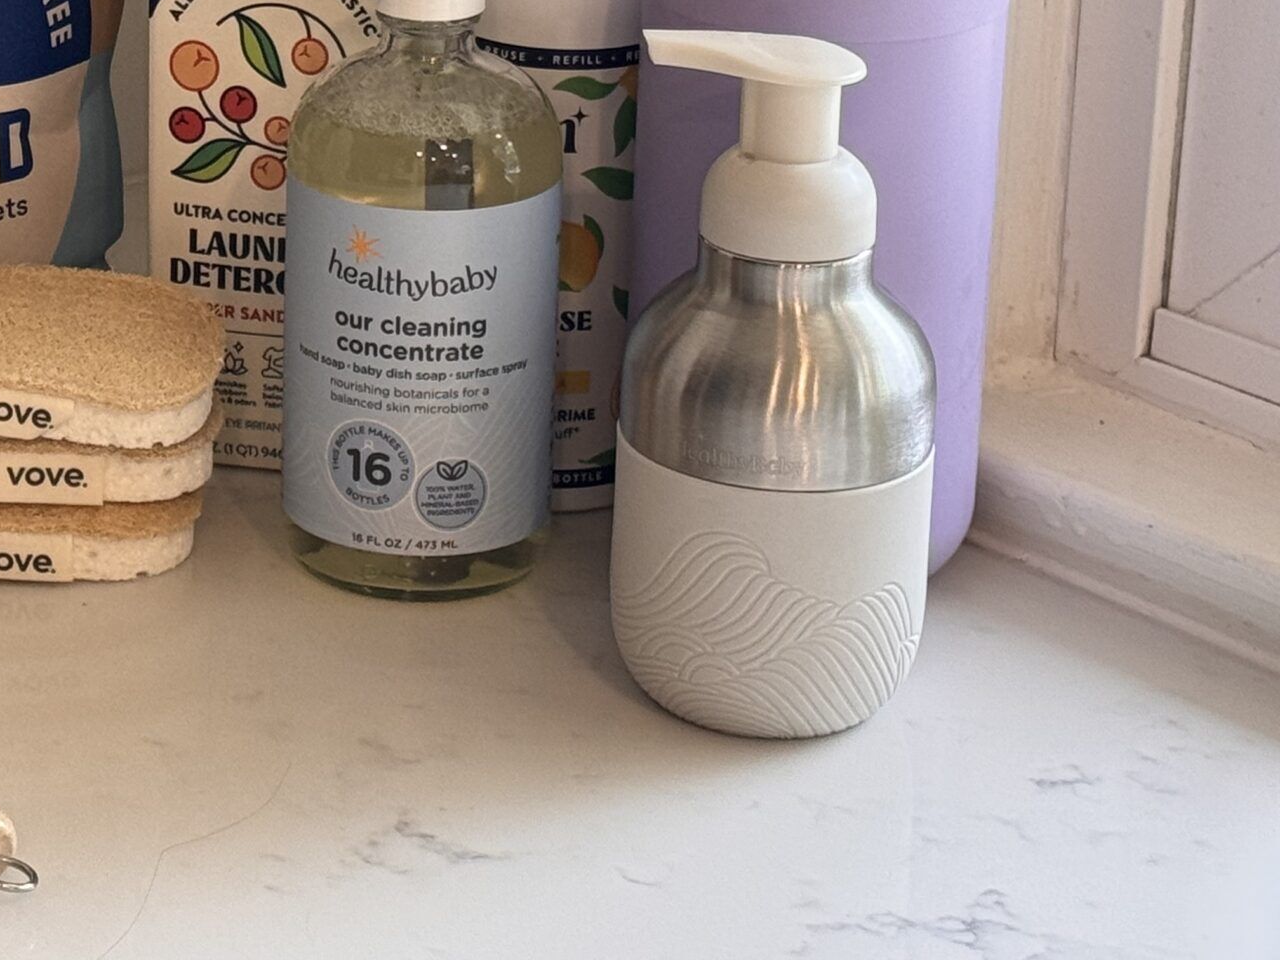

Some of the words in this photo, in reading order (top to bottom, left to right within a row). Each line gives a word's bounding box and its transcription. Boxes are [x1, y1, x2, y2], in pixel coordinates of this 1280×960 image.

[552, 54, 603, 66] REFILL
[174, 202, 223, 221] ULTRA
[328, 247, 498, 302] healthybaby
[334, 310, 373, 331] our
[380, 315, 487, 339] cleaning
[336, 335, 484, 362] concentrate
[299, 343, 320, 362] hand
[321, 355, 346, 371] soap
[352, 361, 382, 380] baby
[386, 367, 413, 381] dish
[415, 371, 448, 383] soap
[455, 365, 500, 381] surface
[502, 358, 528, 374] spray
[330, 376, 391, 398] nourishing
[393, 385, 459, 401] botanicals
[462, 385, 480, 398] for
[482, 386, 491, 397] a
[330, 390, 382, 412] balanced
[386, 400, 411, 414] skin
[414, 401, 490, 415] microbiome
[335, 425, 365, 449] BOTTLE
[368, 426, 402, 451] MAKES
[346, 447, 392, 487] 16
[398, 451, 409, 465] UP
[6, 466, 88, 489] vove.
[400, 467, 410, 481] TO
[345, 486, 391, 506] BOTTLES
[352, 531, 364, 543] 16
[366, 535, 381, 547] FL
[384, 537, 402, 550] OZ
[415, 539, 437, 550] 473
[440, 539, 458, 550] ML
